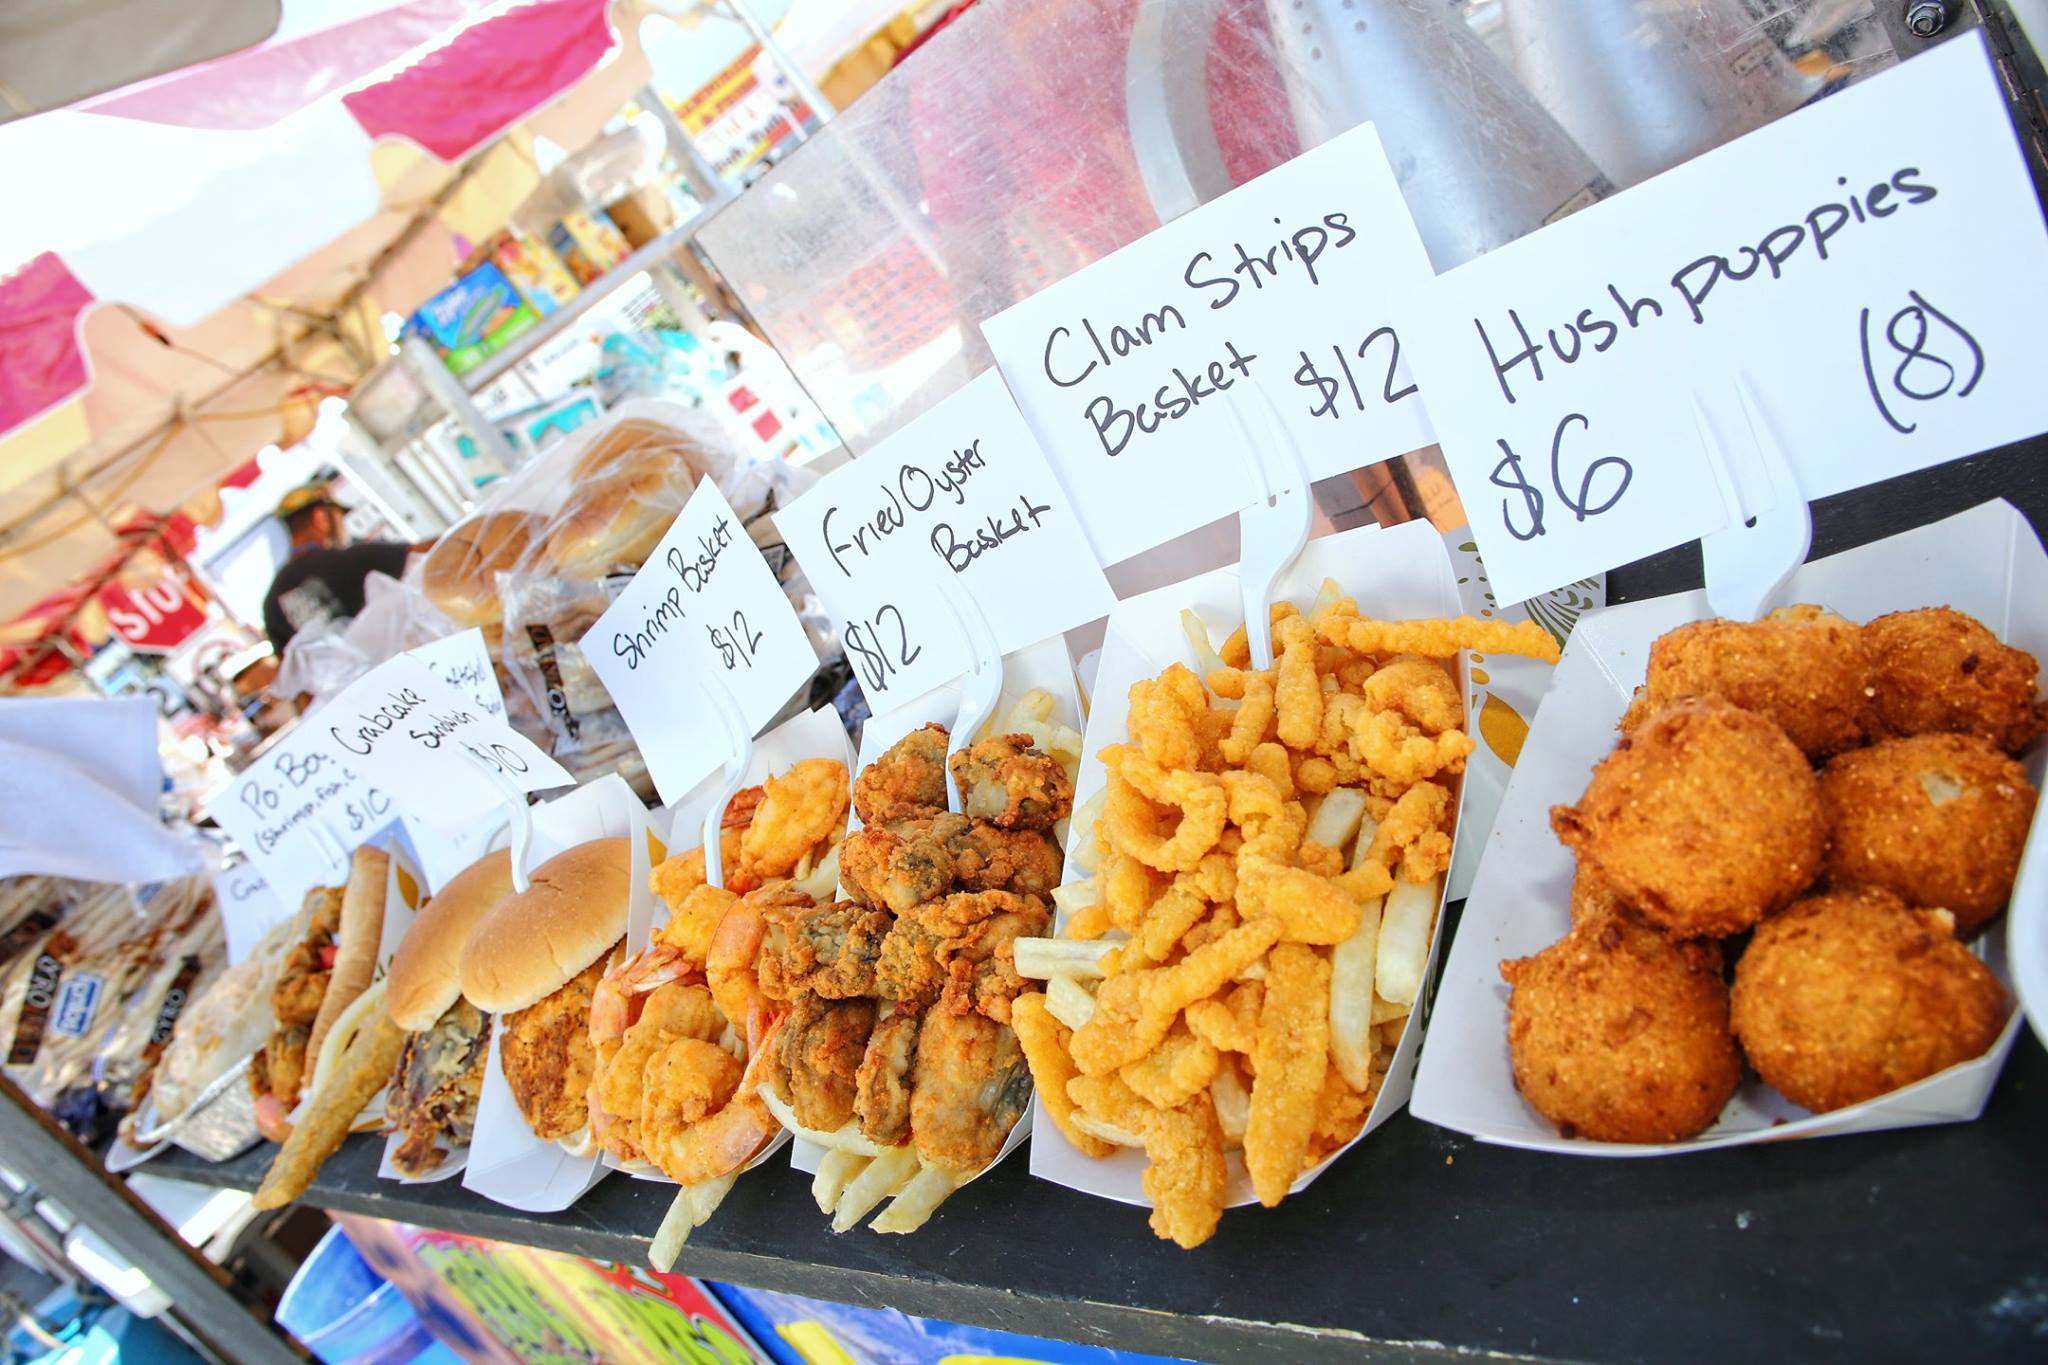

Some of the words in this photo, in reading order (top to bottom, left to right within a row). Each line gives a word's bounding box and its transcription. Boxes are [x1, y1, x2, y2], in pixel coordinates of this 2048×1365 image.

[1044, 306, 1186, 387] Clam
[1184, 213, 1356, 309] Strips
[1084, 342, 1257, 456] Basket
[1294, 326, 1418, 419] $12
[1859, 290, 1985, 433] (8)
[823, 485, 904, 577] Fried
[899, 439, 986, 511] Oyster
[1489, 412, 1633, 541] $6
[931, 496, 1050, 573] Basket
[108, 564, 188, 640] STO
[614, 587, 686, 671] Shrimp
[667, 514, 733, 594] Basket
[706, 610, 763, 671] $12
[845, 604, 921, 691] $12
[331, 688, 427, 755] Crabcake
[240, 753, 336, 820] Po-Bo
